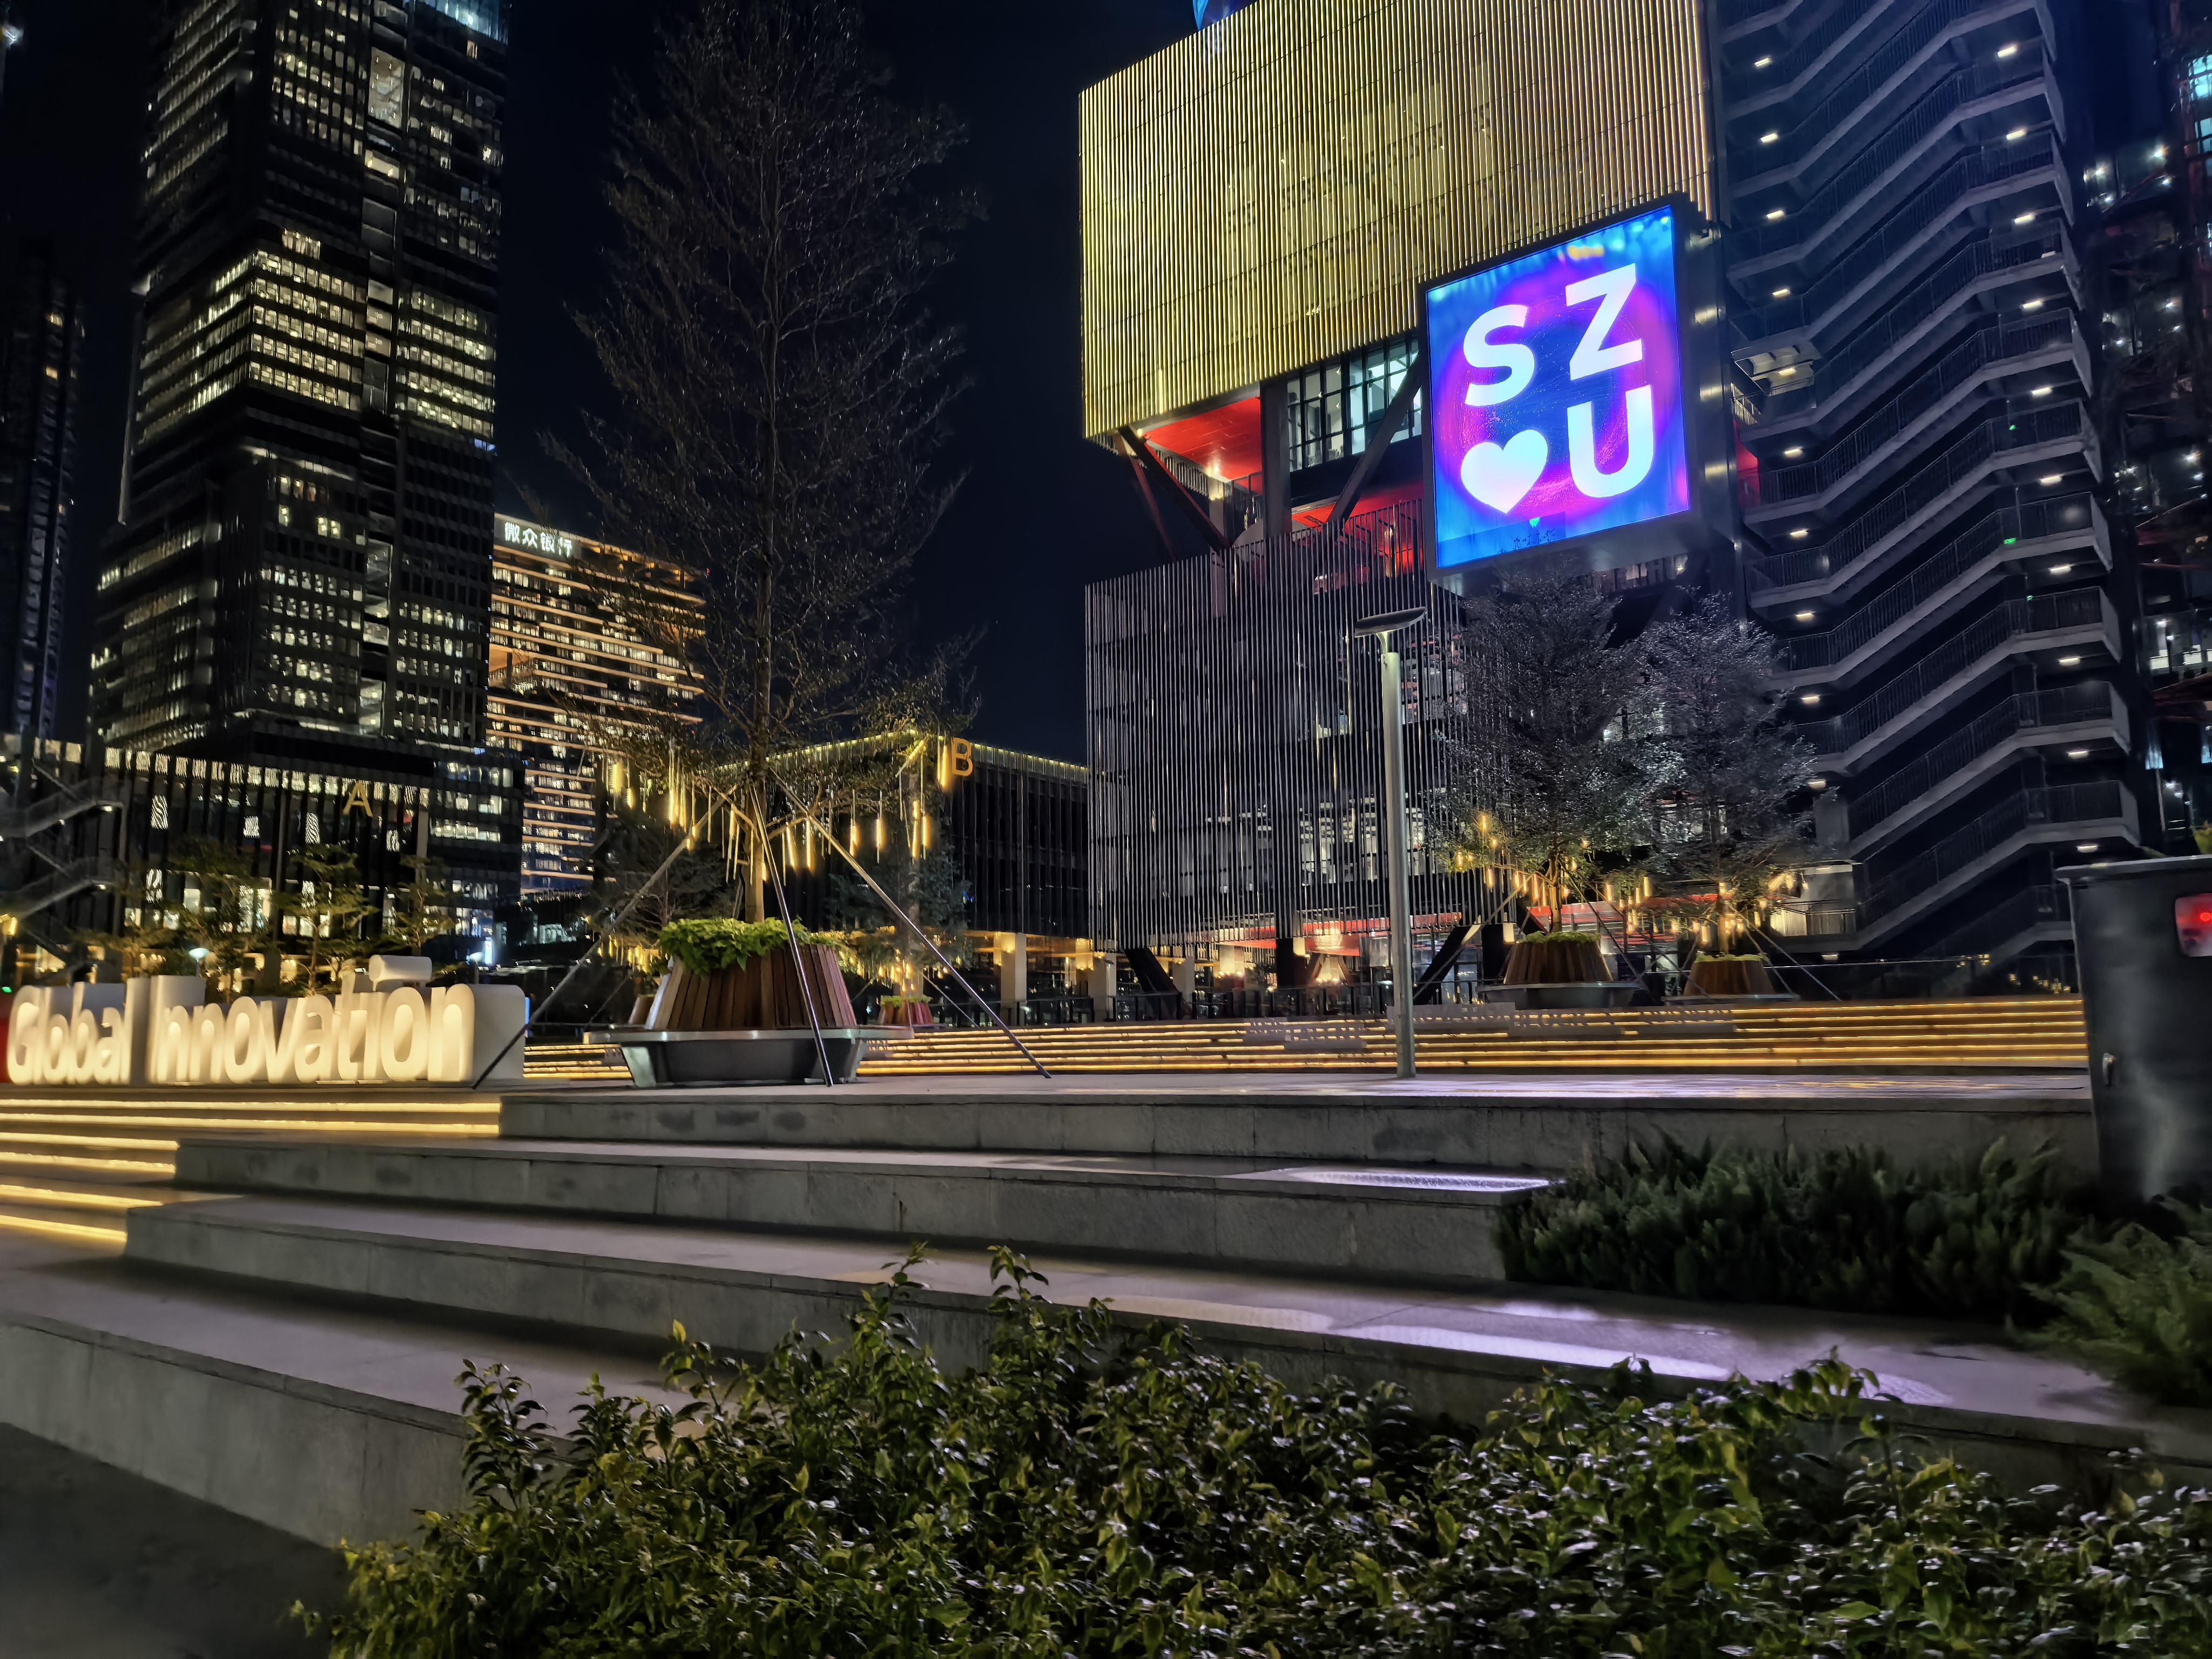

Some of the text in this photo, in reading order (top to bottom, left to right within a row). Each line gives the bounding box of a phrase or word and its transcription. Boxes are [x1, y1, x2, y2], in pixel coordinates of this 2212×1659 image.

[1567, 385, 1654, 498] U
[951, 737, 973, 777] B
[343, 781, 373, 818] A
[6, 955, 475, 1085] Global Innovation
